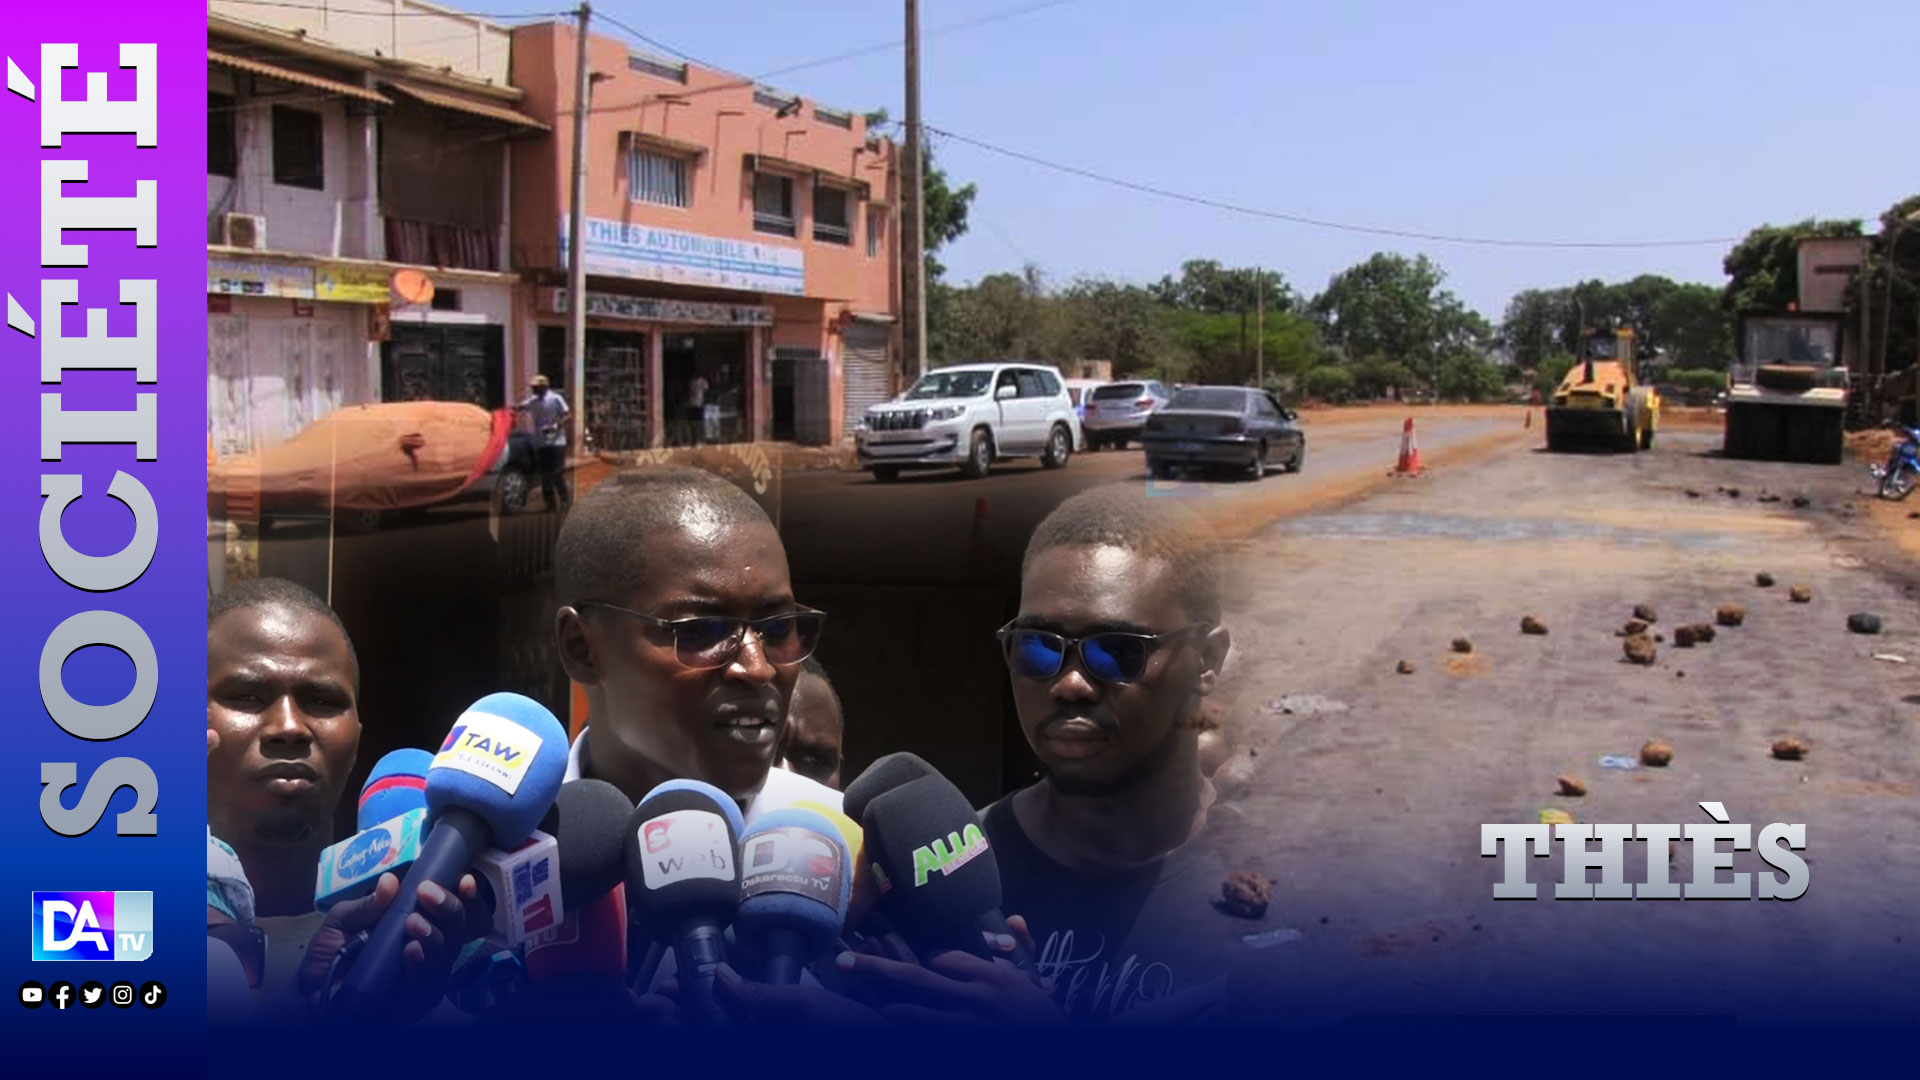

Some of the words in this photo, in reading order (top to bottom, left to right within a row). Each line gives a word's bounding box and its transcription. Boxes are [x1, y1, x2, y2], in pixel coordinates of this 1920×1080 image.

[588, 220, 642, 245] THIES
[645, 232, 746, 261] AUTOMOBILE
[465, 732, 521, 762] TAW
[658, 849, 727, 876] web
[811, 877, 830, 891] TV
